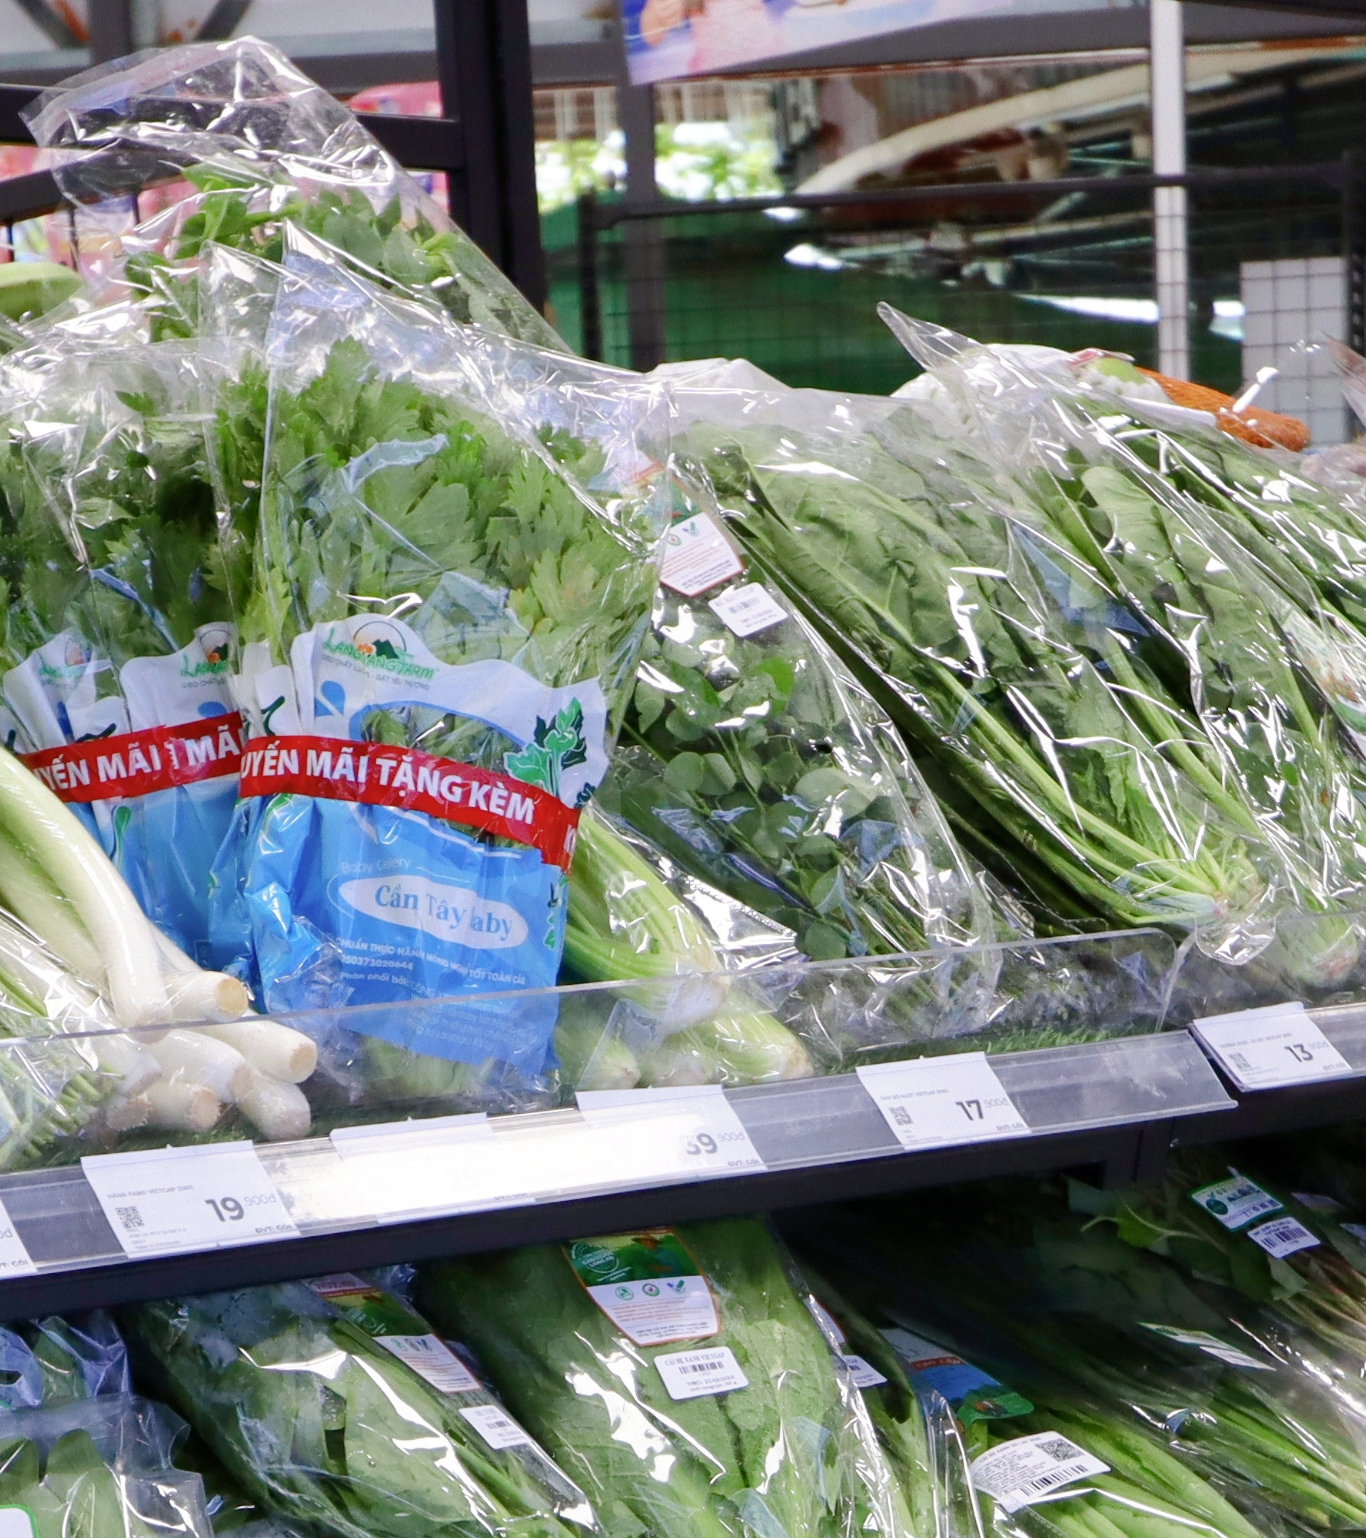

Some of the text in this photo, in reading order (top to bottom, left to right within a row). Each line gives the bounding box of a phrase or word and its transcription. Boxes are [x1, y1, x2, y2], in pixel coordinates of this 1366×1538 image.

[306, 748, 367, 784] MÃI
[376, 754, 465, 805] TẶNG
[468, 774, 536, 825] KÈM
[375, 883, 419, 910] Cần
[426, 892, 467, 930] Tây
[1284, 1043, 1315, 1064] 13
[955, 1099, 986, 1121] 17
[204, 1196, 245, 1223] 19
